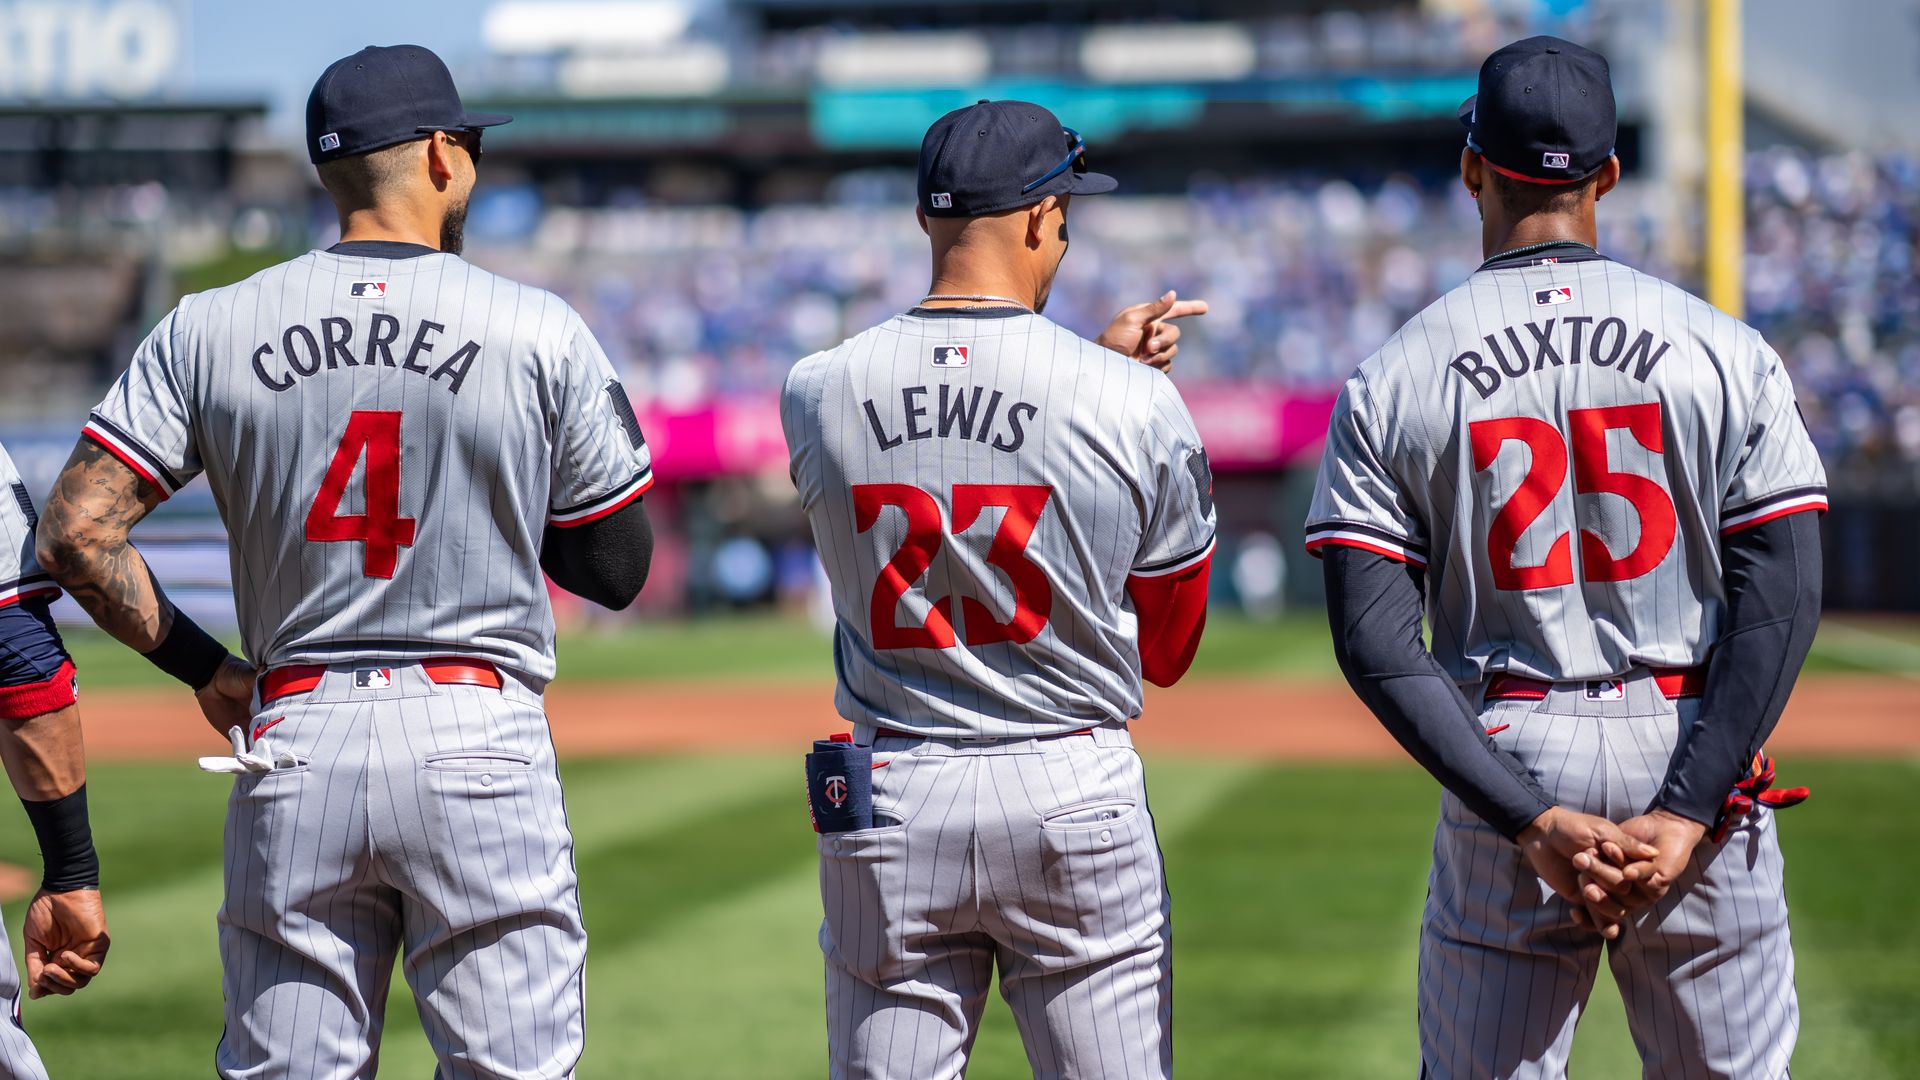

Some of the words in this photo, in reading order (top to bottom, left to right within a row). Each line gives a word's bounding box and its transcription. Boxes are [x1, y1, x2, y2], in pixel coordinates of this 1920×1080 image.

[252, 313, 482, 394] CORREA
[1450, 316, 1670, 400] BUXTON
[863, 384, 1038, 453] LEWIS
[305, 410, 416, 579] 4
[1469, 402, 1677, 590] 25
[852, 483, 1053, 650] 23
